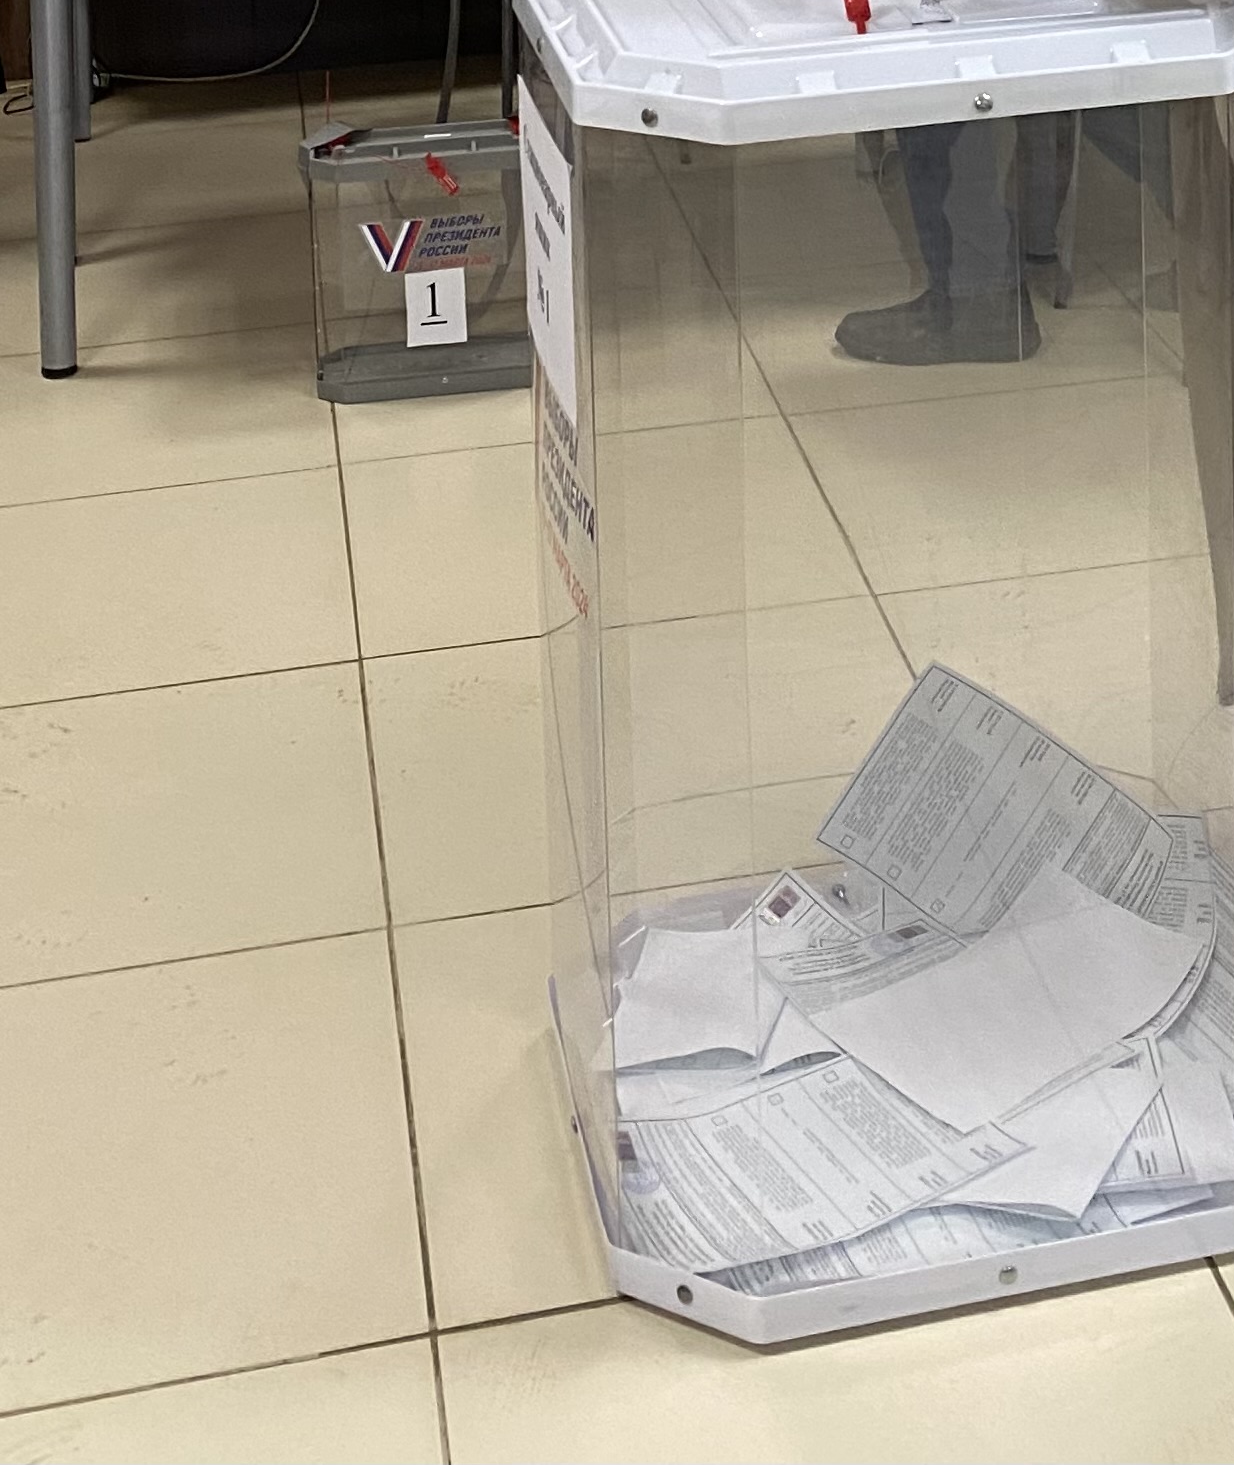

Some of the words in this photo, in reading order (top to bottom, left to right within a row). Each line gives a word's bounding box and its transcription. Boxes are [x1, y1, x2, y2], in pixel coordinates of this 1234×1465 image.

[430, 214, 485, 229] ВЫБОРЫ
[424, 226, 501, 243] ПРЕЗИДЕНТА
[418, 243, 469, 258] РОССИИ
[426, 282, 441, 318] 1
[543, 421, 595, 543] ПРЕЗИДЕНТА
